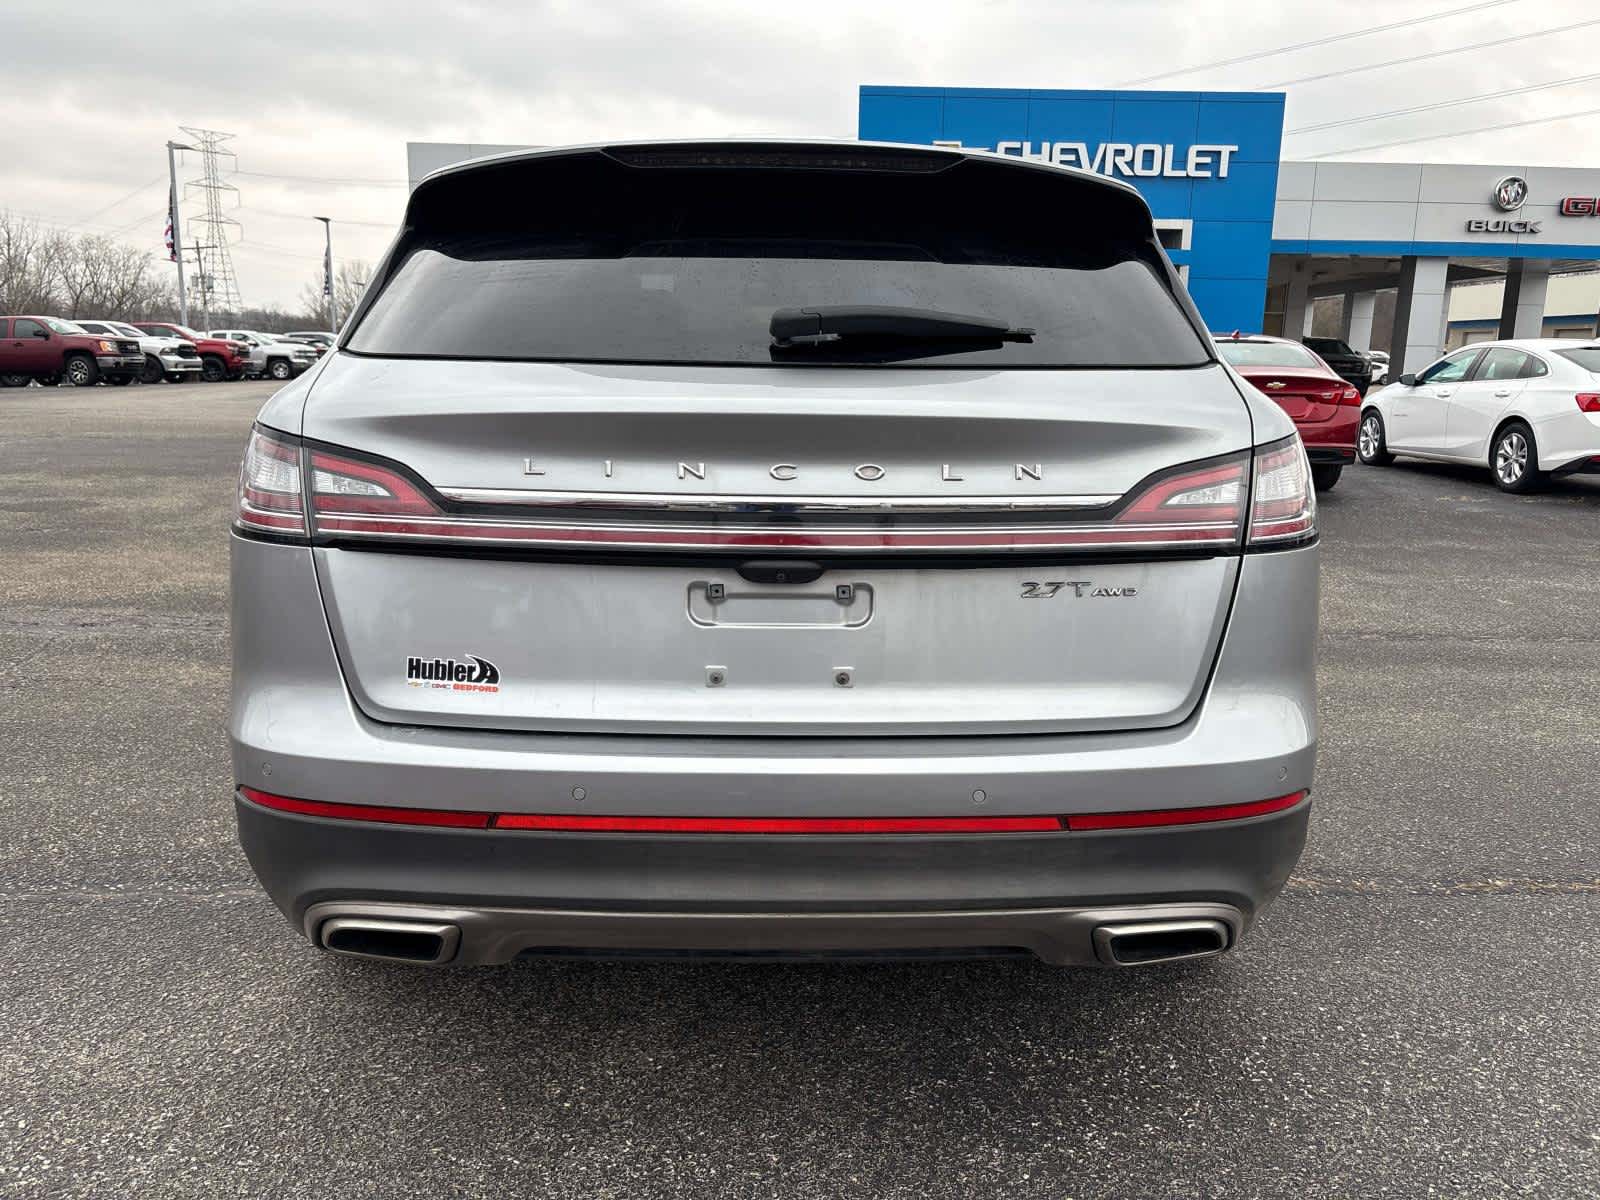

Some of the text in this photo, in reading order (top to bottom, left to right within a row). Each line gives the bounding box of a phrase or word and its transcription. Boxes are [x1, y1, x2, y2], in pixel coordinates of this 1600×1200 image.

[1466, 220, 1543, 233] BUICK
[523, 457, 1043, 482] LINCOLN
[1091, 587, 1137, 597] AWD
[407, 657, 477, 683] Hubler
[453, 683, 498, 692] BEDFORD
